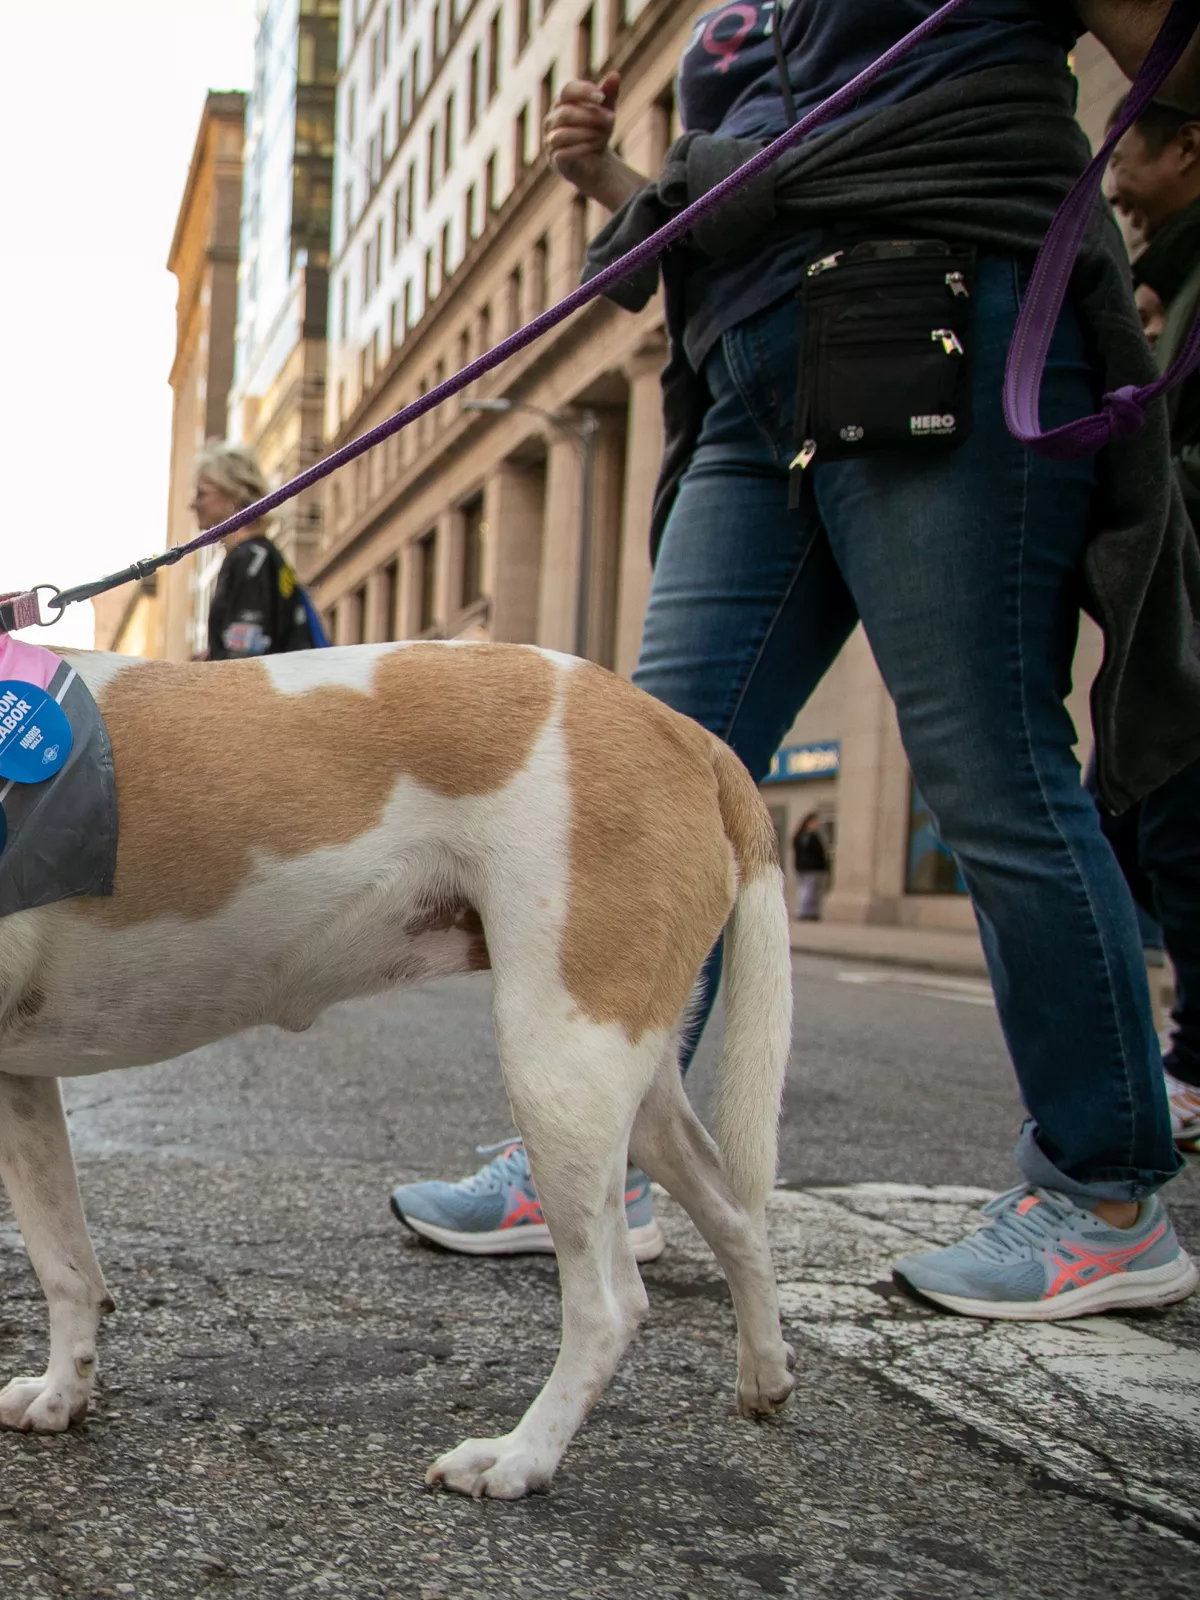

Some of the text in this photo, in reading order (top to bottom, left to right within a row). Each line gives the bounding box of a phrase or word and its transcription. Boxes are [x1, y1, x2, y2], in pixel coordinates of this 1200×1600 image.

[910, 414, 955, 428] HERO
[19, 725, 41, 750] HARRIS
[29, 734, 44, 750] WALZ
